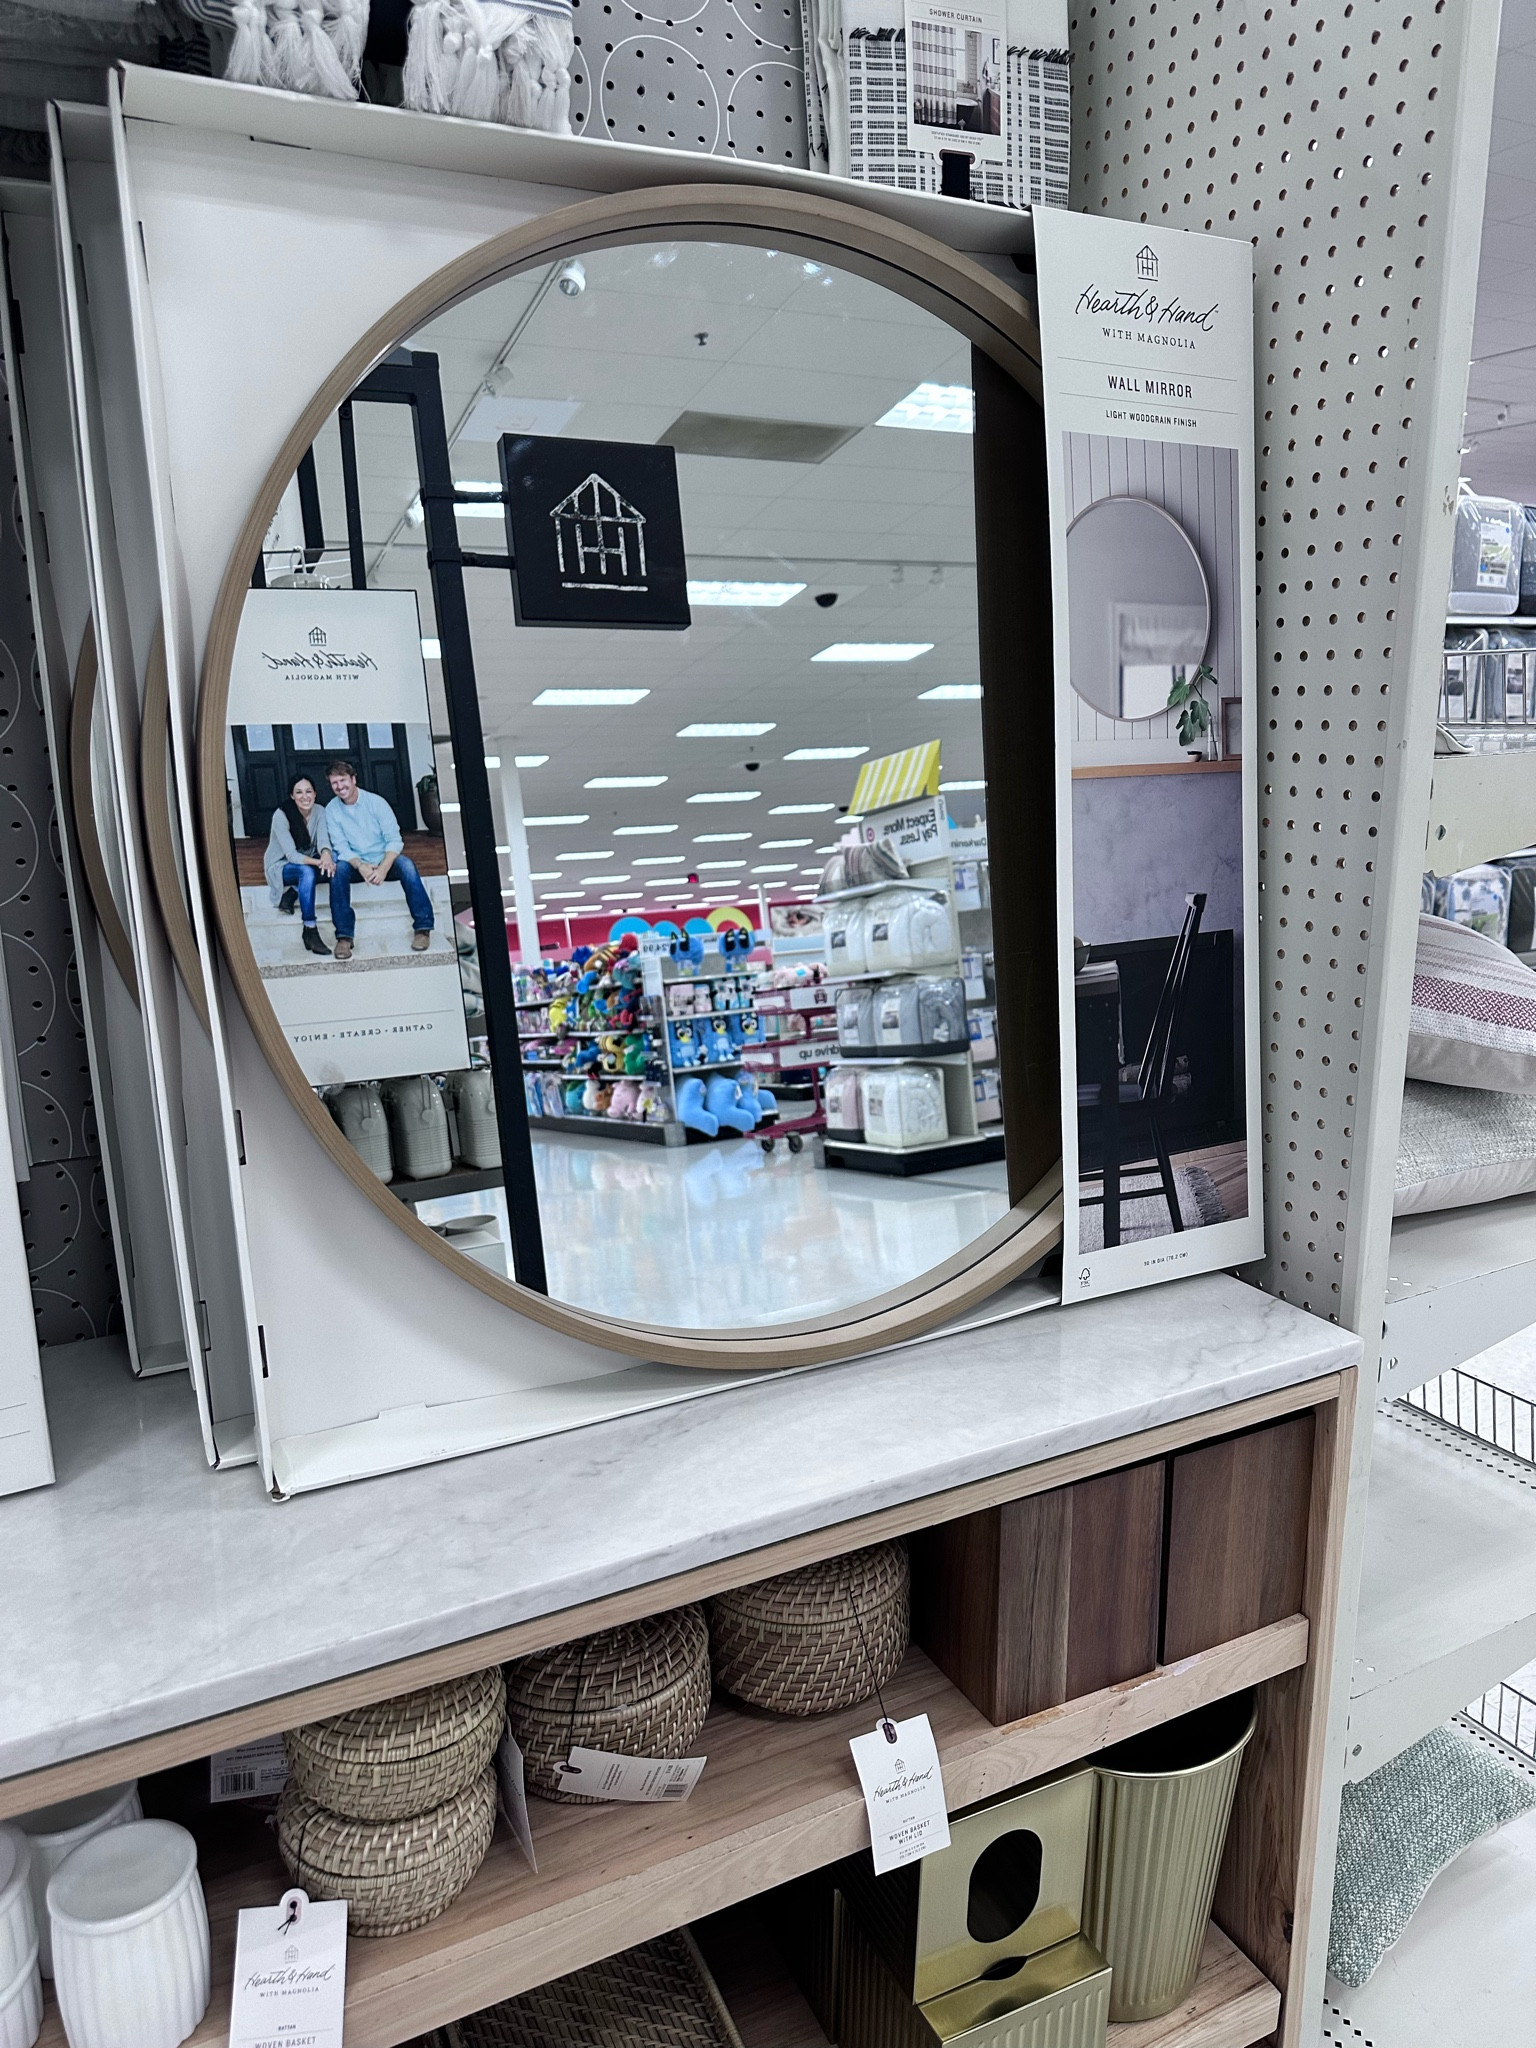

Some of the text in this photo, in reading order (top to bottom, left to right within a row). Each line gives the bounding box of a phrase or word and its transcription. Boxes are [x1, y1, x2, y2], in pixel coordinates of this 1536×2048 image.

[929, 8, 983, 23] SHOWER CURTAIN
[1075, 283, 1219, 332] Hearth & Hand
[1102, 327, 1196, 349] WITH MAGNOLIA
[1107, 375, 1193, 399] WALL MIRROR
[1105, 410, 1197, 428] LIGHT WOODGRAIN FINISH
[873, 1776, 902, 1802] Hearth
[908, 1765, 934, 1787] Hand
[889, 1820, 931, 1841] WOVEN BASKET
[898, 1834, 913, 1845] WITH
[244, 1966, 292, 1991] Hearth
[295, 1963, 336, 1984] Hand
[260, 1986, 319, 1998] WITH MAGNOLIA
[286, 2036, 317, 2047] BASKET
